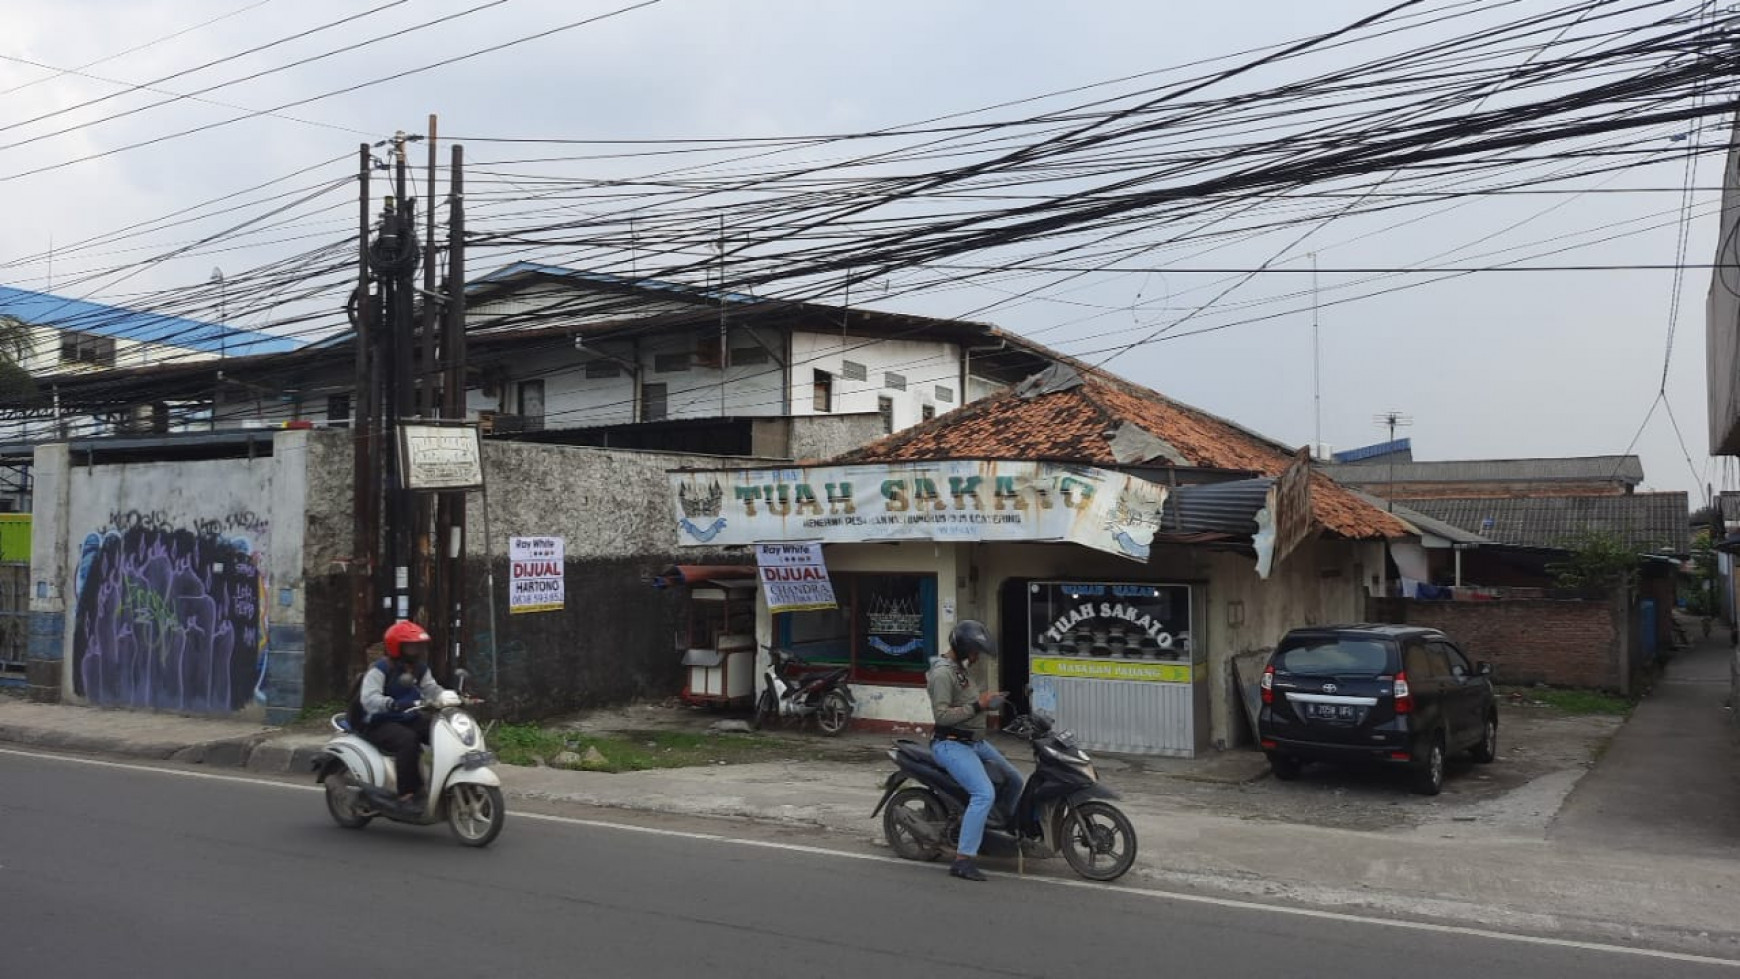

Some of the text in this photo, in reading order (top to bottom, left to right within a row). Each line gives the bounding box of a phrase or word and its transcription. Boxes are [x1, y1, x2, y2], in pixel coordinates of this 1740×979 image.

[735, 482, 856, 517] TUAH
[763, 544, 810, 555] Ray White
[514, 562, 561, 578] DIJUAL
[764, 566, 826, 581] DIJUAL
[515, 581, 560, 593] HARTONO
[770, 584, 831, 597] CHANDRA
[1046, 602, 1173, 648] TUAH SAKATO
